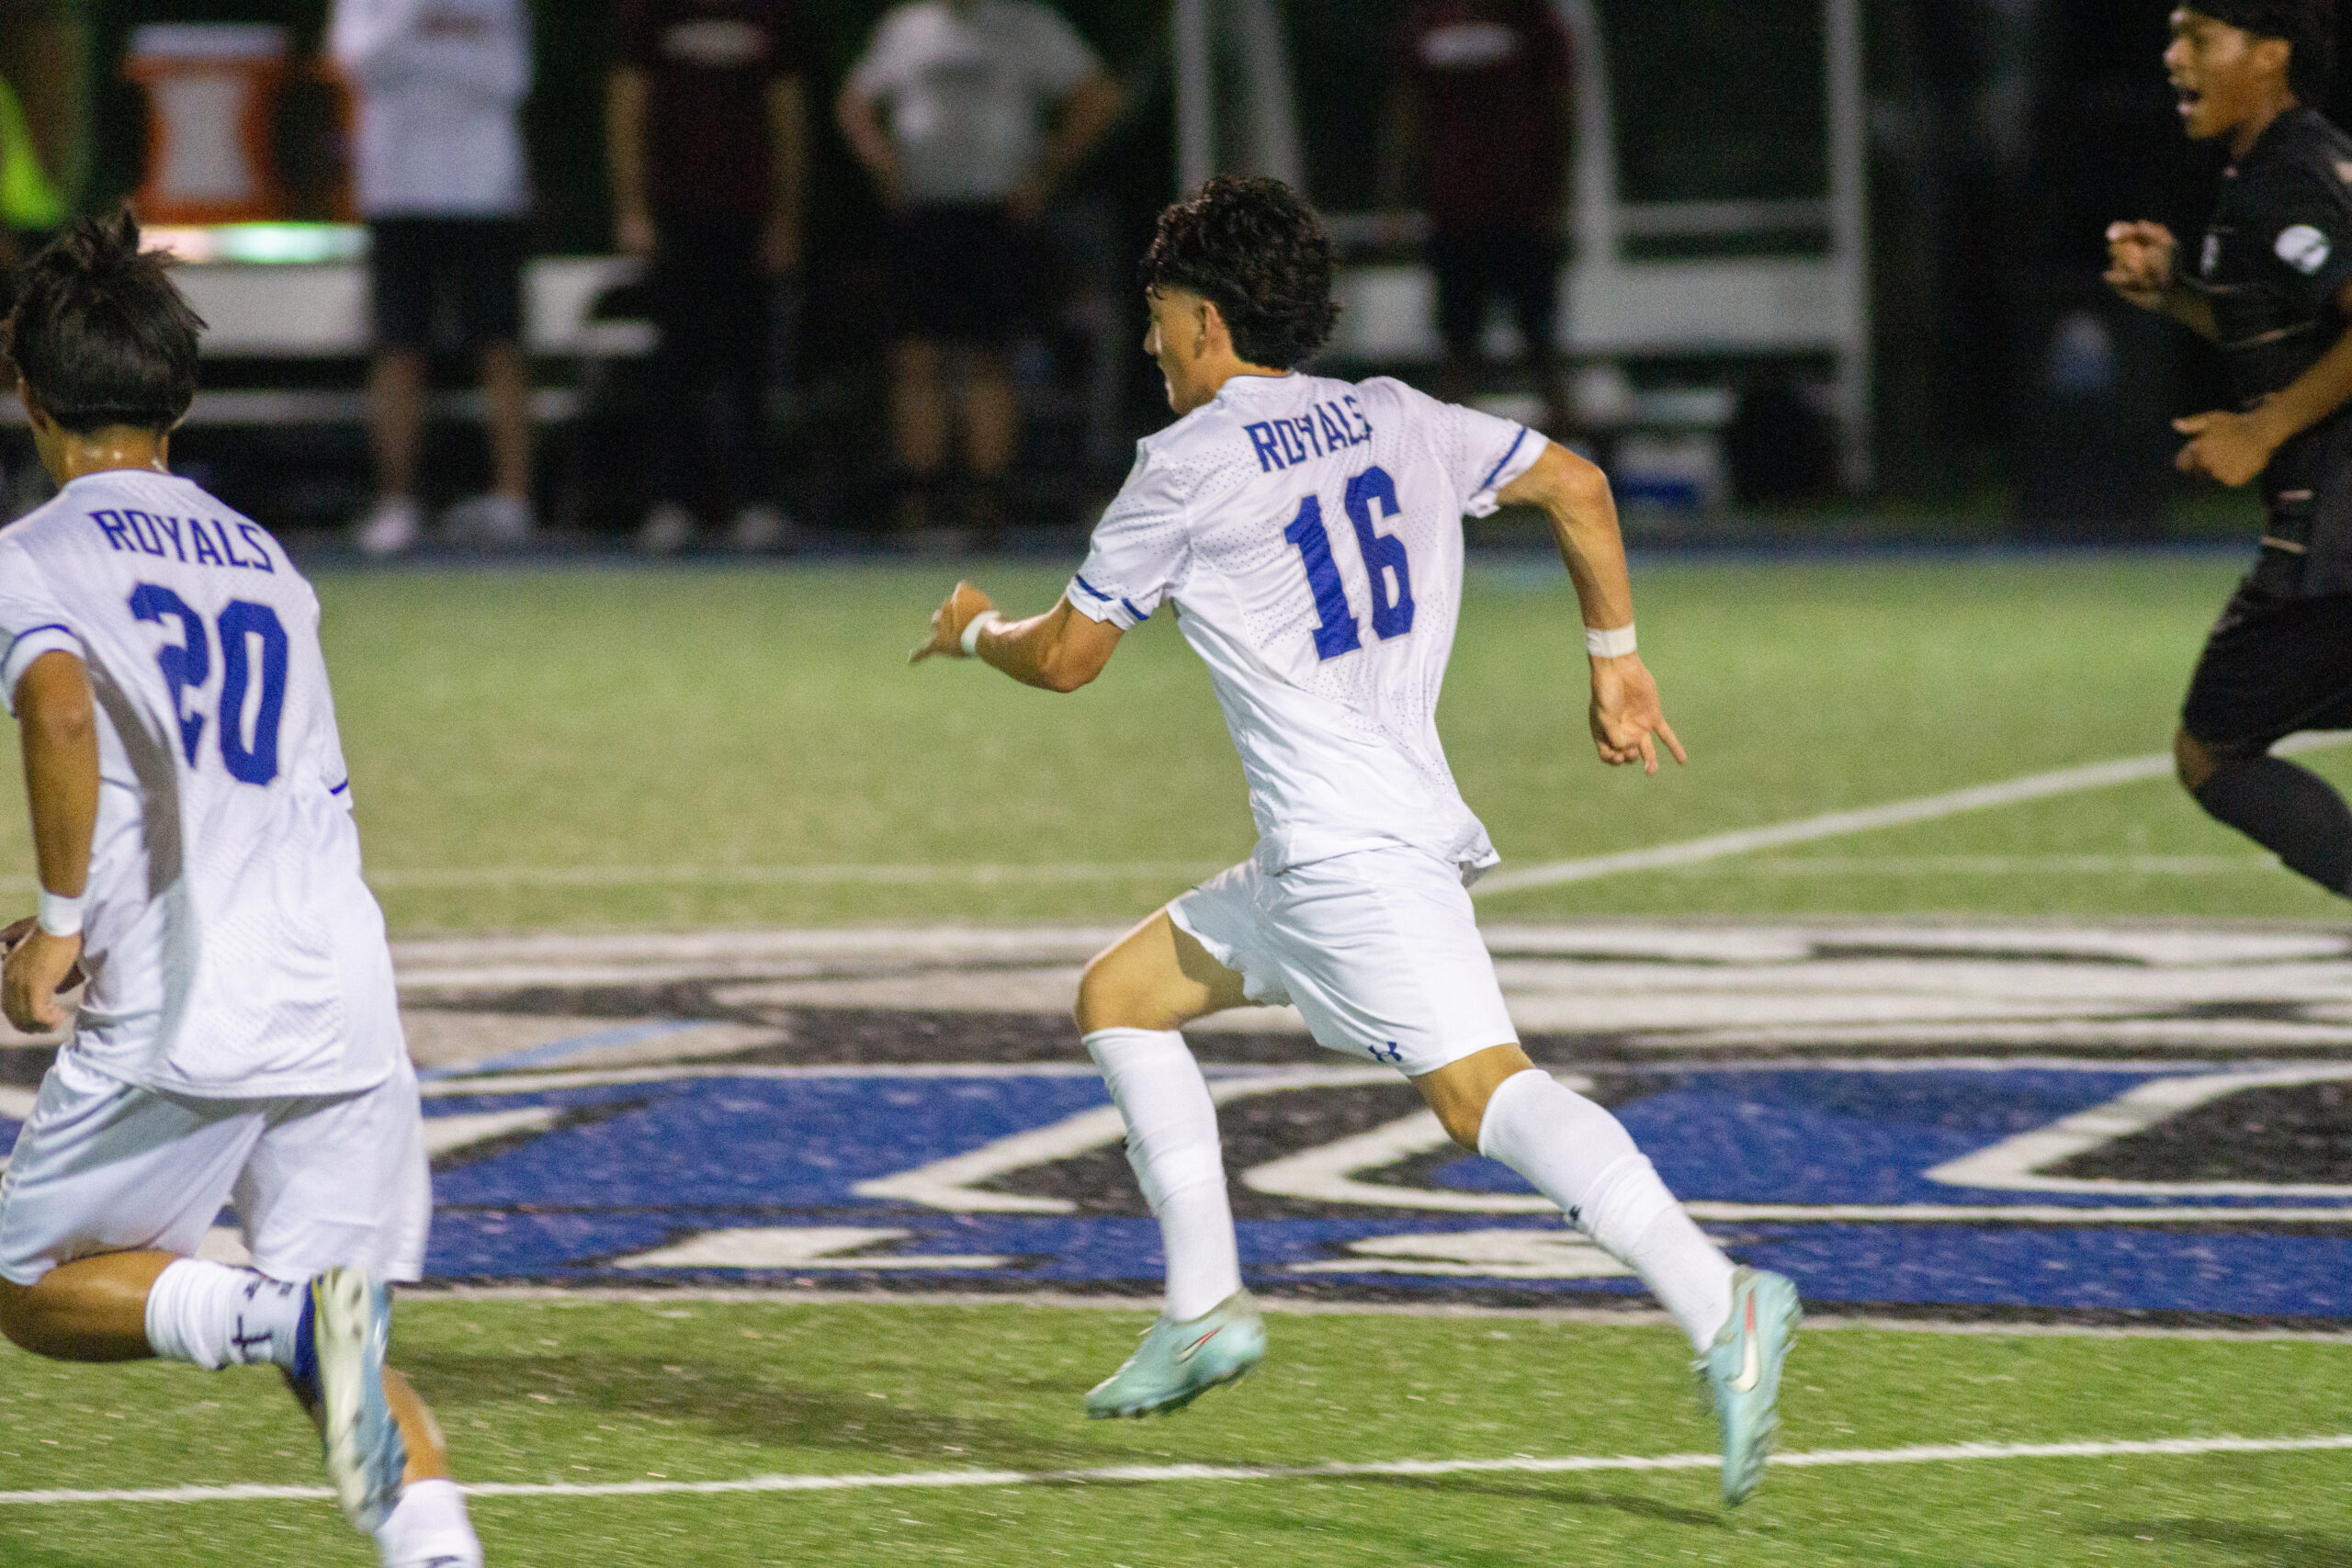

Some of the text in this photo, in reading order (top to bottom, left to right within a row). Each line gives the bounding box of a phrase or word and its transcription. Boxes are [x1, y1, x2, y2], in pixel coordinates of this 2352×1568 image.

[1242, 394, 1374, 473] ROYALS
[88, 509, 275, 574] ROYALS
[1283, 465, 1415, 661] 16
[128, 581, 288, 786] 20
